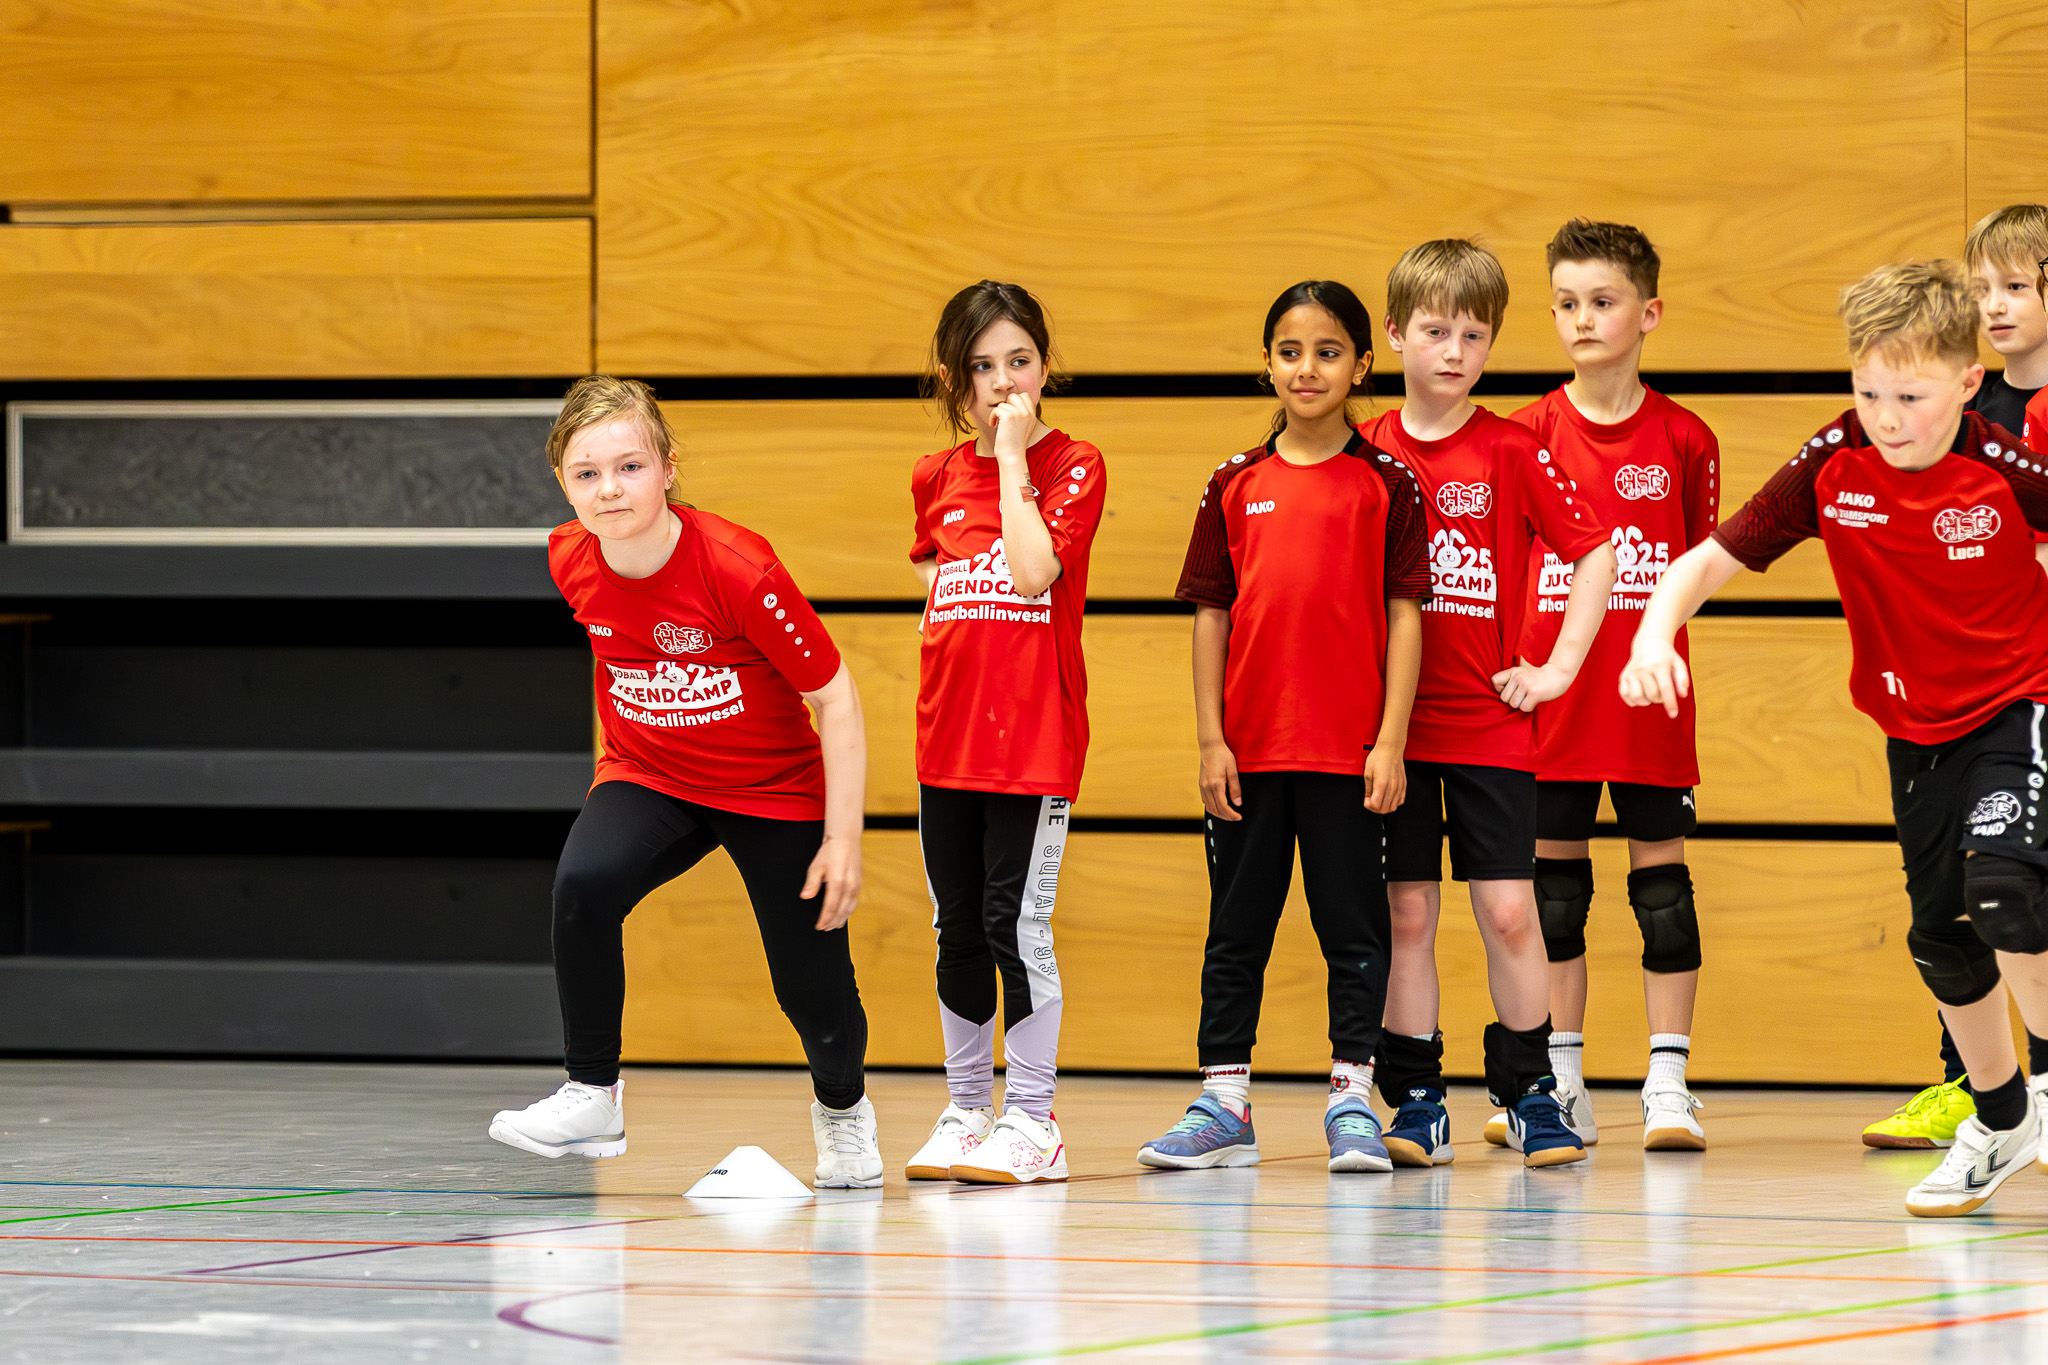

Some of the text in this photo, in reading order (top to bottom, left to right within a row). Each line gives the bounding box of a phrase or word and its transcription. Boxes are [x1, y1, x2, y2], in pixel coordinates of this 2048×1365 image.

[1836, 490, 1876, 509] JAKO
[1245, 500, 1276, 516] JAKO
[942, 509, 966, 526] JAKO
[1947, 545, 1985, 561] Luca
